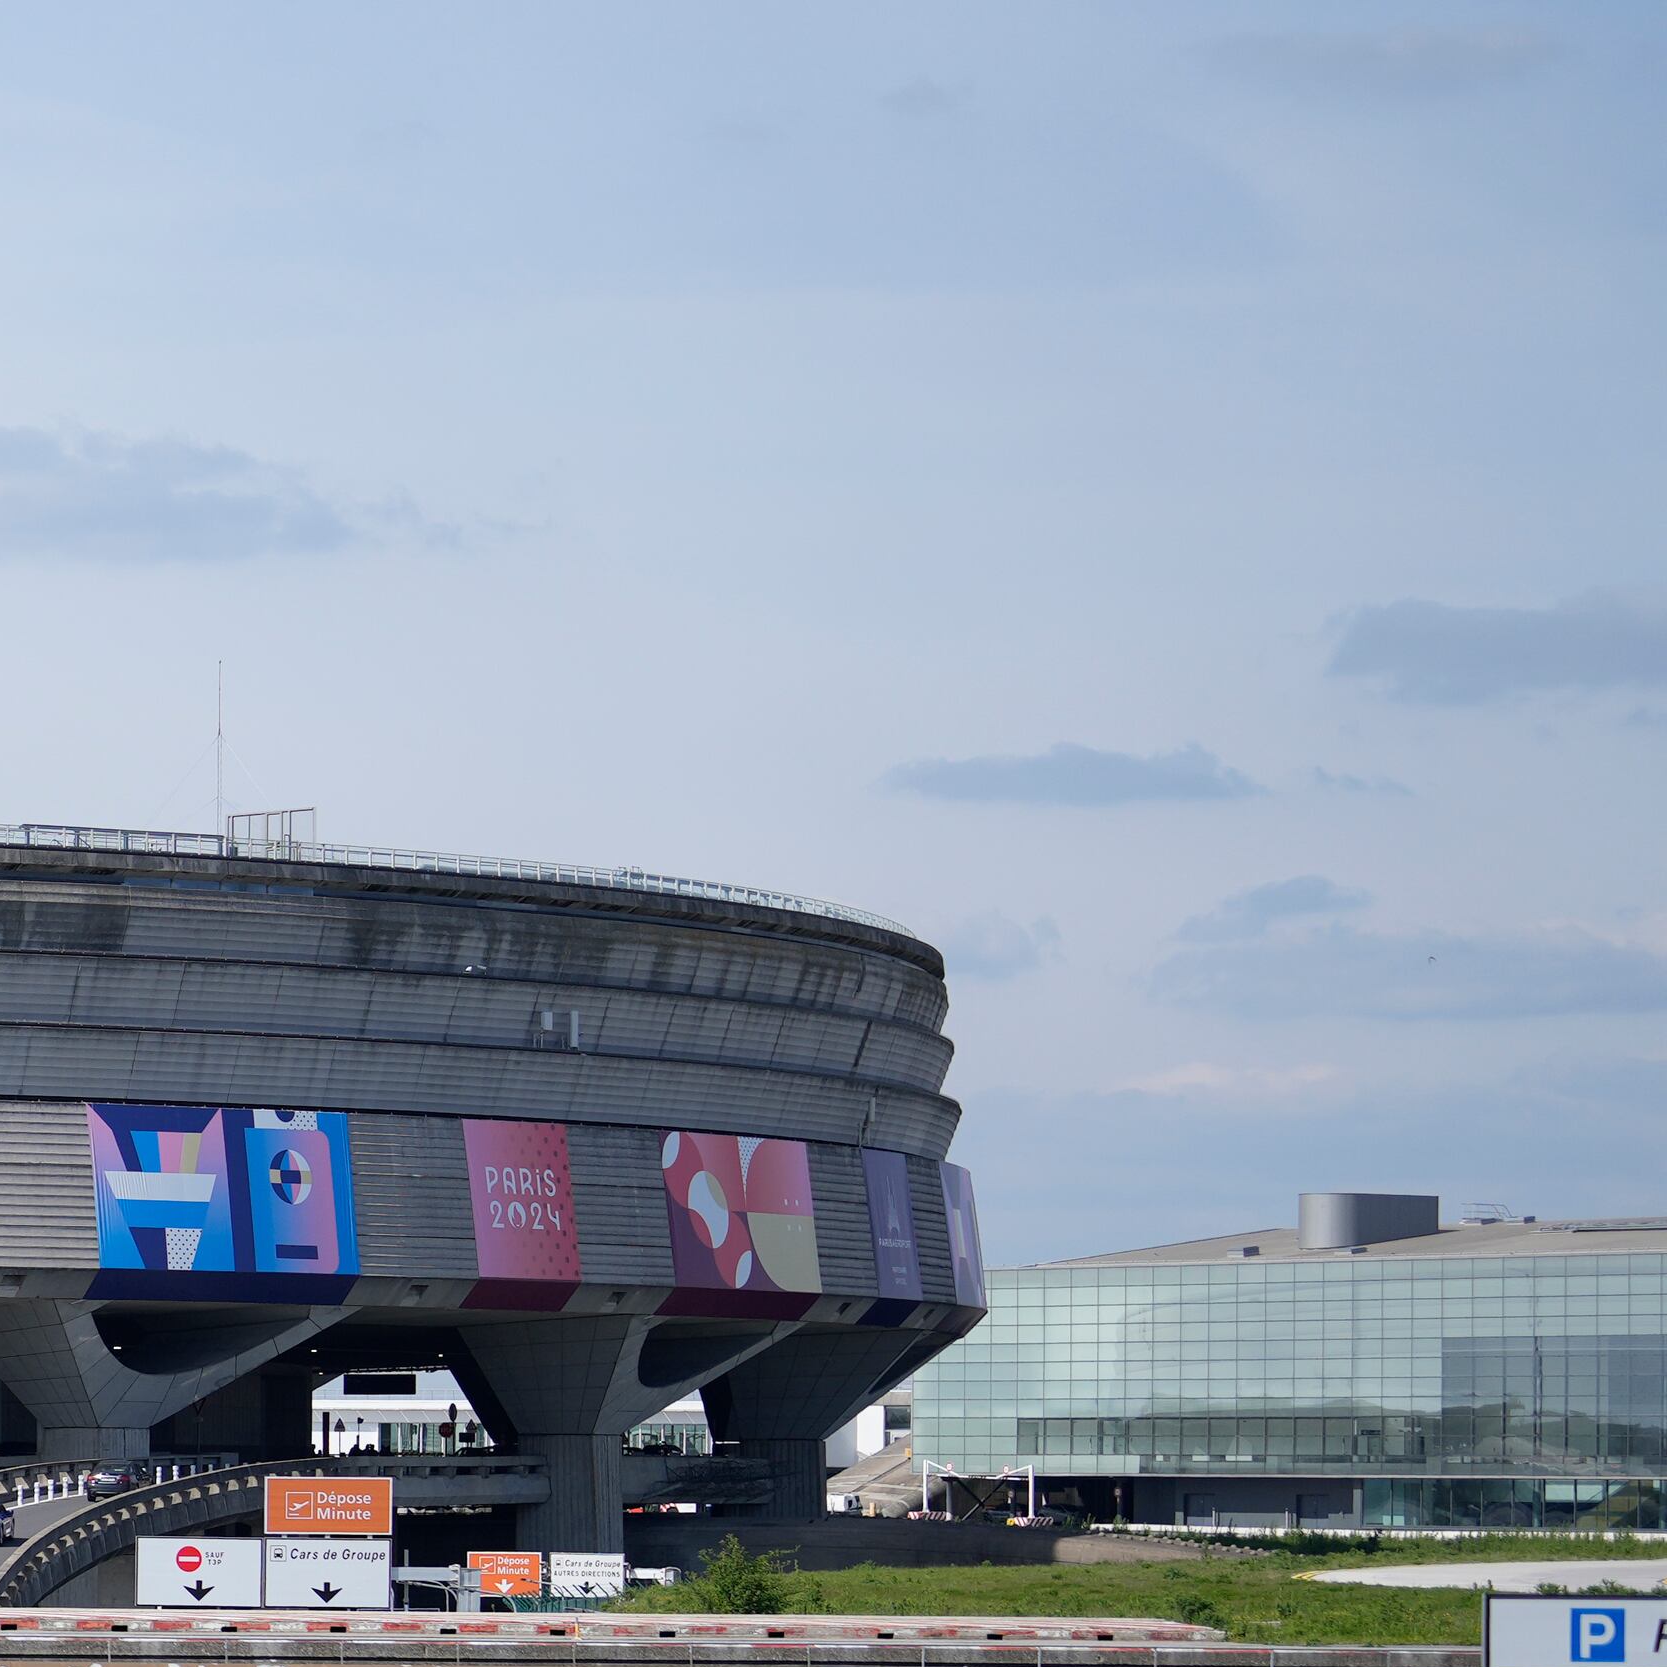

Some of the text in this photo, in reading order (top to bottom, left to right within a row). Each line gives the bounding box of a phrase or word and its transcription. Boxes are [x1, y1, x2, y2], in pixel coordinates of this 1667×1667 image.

[490, 1200, 560, 1231] 2024
[317, 1491, 372, 1506] Dépose
[317, 1507, 371, 1520] Minute
[290, 1548, 386, 1563] Cars de Groupe
[497, 1555, 530, 1566] Dépose
[497, 1566, 530, 1575] Minute
[564, 1559, 621, 1569] Cars de Groupe
[581, 1570, 621, 1578] DIRECTIONS
[1579, 1613, 1616, 1659] P
